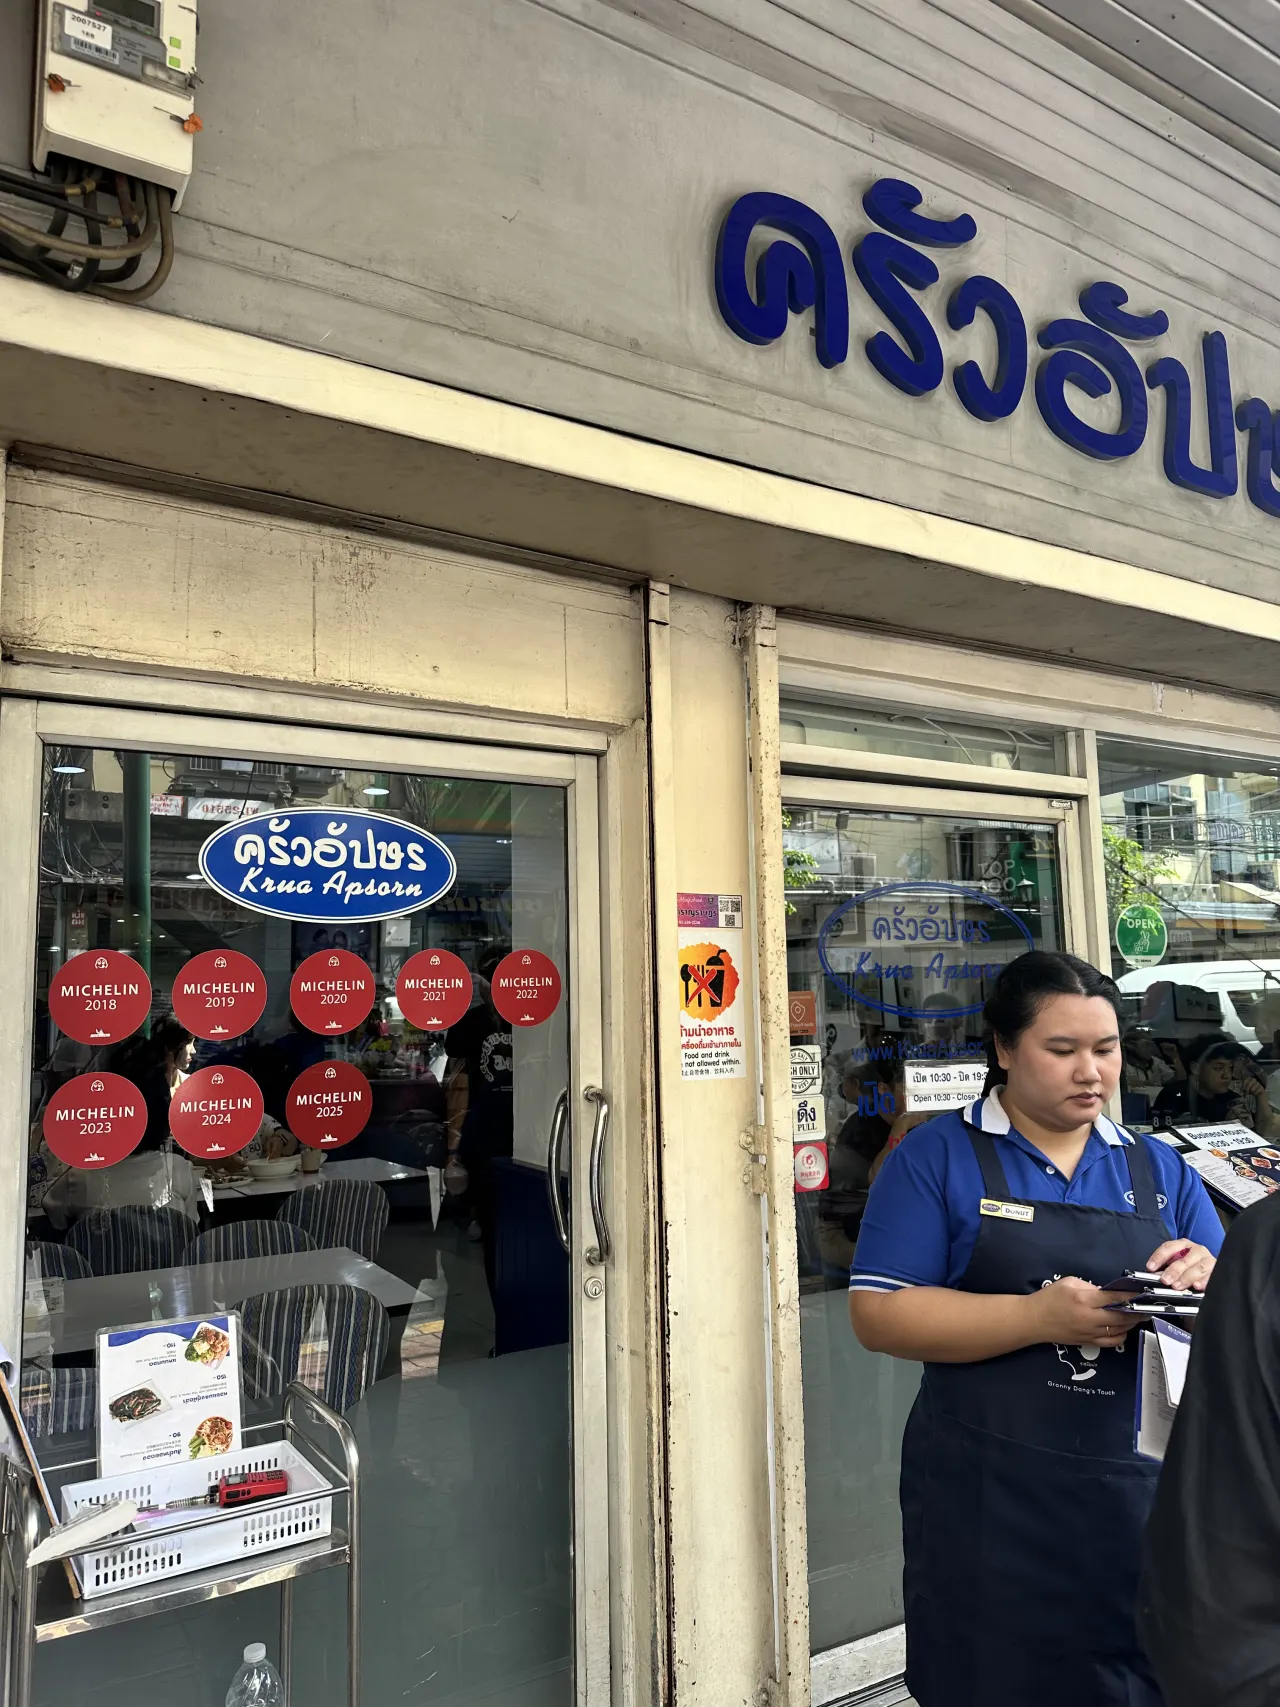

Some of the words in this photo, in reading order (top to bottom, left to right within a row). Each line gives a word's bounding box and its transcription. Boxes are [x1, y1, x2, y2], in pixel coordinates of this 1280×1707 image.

[71, 14, 107, 32] 2007527
[234, 818, 427, 871] ครัวอัปษร
[239, 867, 313, 894] Krua
[322, 870, 423, 905] Apsorn
[1127, 918, 1155, 929] OPEN
[855, 952, 913, 979] Krua
[300, 979, 365, 992] MICHELIN
[404, 978, 464, 989] MICHELIN
[499, 976, 553, 988] MICHELIN
[61, 983, 139, 997] MICHELIN
[183, 982, 256, 995] MICHELIN
[516, 989, 538, 999] 2022
[320, 993, 347, 1004] 2020
[422, 991, 446, 1001] 2021
[84, 999, 117, 1011] 2018
[205, 997, 235, 1008] 2019
[680, 1024, 735, 1037] ้ามนำอาหาร
[684, 1052, 699, 1060] Food
[714, 1050, 730, 1058] drink
[852, 1039, 987, 1062] www.KruaApsor
[697, 1059, 720, 1067] allowed
[799, 1066, 816, 1076] ONLY
[913, 1071, 928, 1082] เปิด
[930, 1072, 951, 1083] 10:30
[958, 1071, 970, 1081] ปิด
[973, 1071, 988, 1081] 19:3
[296, 1090, 362, 1106] MICHELIN
[913, 1094, 932, 1103] Open
[934, 1093, 951, 1102] 10:30
[956, 1093, 976, 1101] Close
[180, 1098, 252, 1113] MICHELIN
[797, 1100, 817, 1123] ดึง
[55, 1106, 135, 1121] MICHELIN
[316, 1106, 343, 1118] 2025
[201, 1114, 231, 1126] 2024
[79, 1122, 112, 1135] 2023
[797, 1122, 817, 1132] PULL
[1005, 1208, 1030, 1217] DONUT
[1047, 1380, 1071, 1391] Granny
